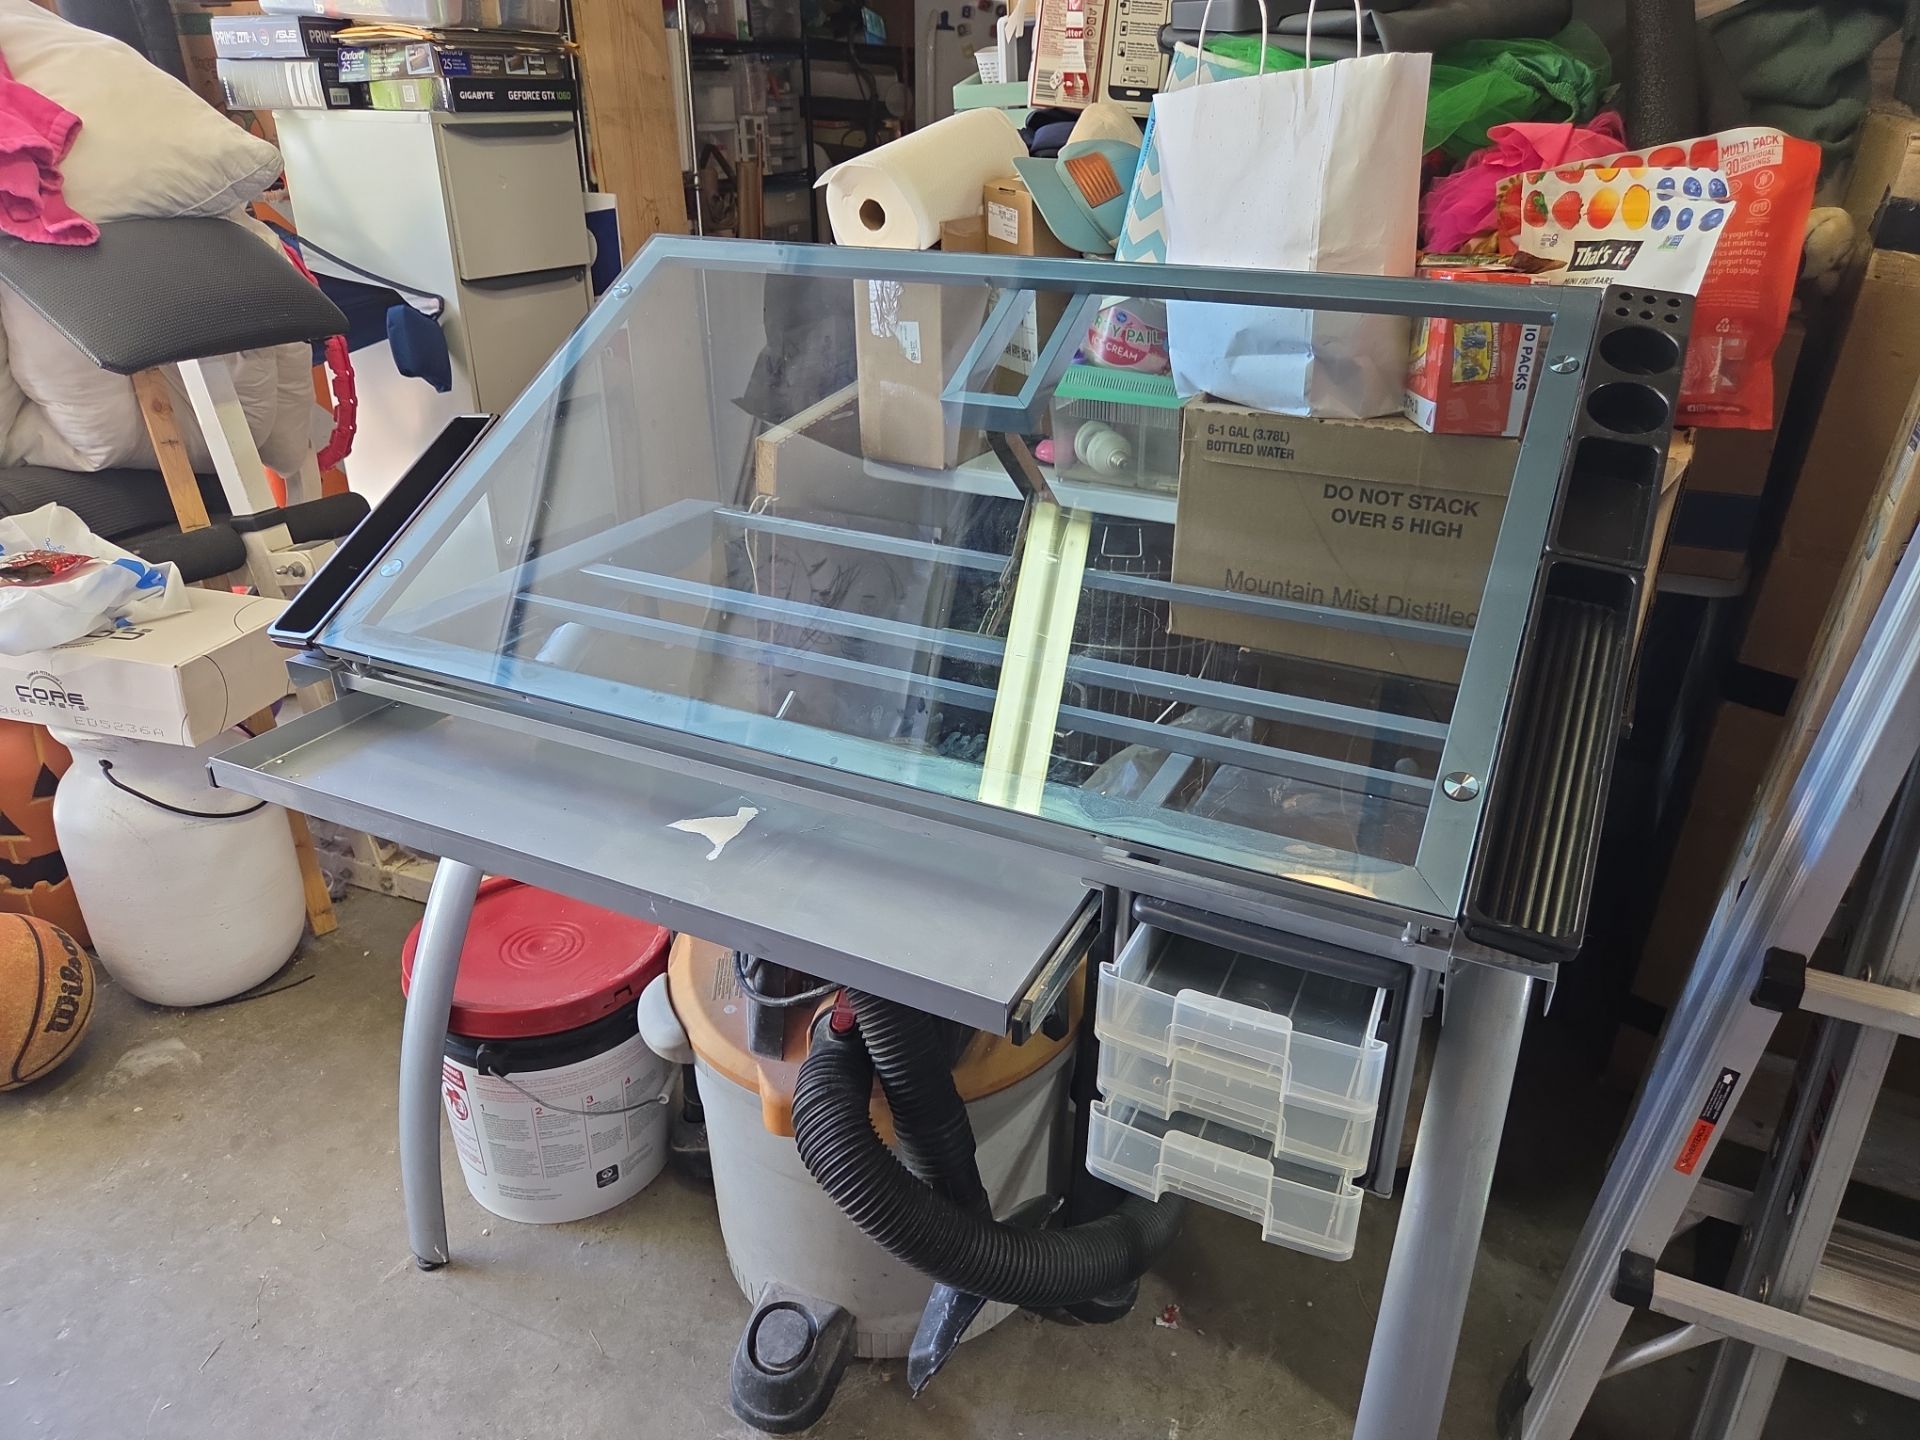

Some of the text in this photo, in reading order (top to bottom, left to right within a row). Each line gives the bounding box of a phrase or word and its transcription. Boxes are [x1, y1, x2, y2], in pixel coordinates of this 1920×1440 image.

[275, 30, 297, 39] ASUS
[340, 50, 364, 61] Oxford
[342, 61, 351, 72] 25
[442, 58, 453, 70] 25
[459, 91, 494, 100] GIGABYTE
[507, 90, 540, 100] GEFORCE
[541, 91, 555, 100] GTX
[1721, 135, 1780, 159] MULTI PACK
[1740, 149, 1776, 163] INDIVIDUAL
[1740, 157, 1772, 171] SERVINGS
[1726, 158, 1740, 176] 30
[1574, 244, 1632, 267] That's it
[1743, 248, 1767, 258] dietary
[1564, 277, 1614, 285] MINI FRUIT BARS
[1126, 328, 1161, 345] PAIL
[1105, 342, 1138, 361] CREAM
[1514, 327, 1538, 391] 10 PACKS
[1207, 424, 1291, 445] 6-1 GAL (3.78L)
[1206, 440, 1295, 460] BOTTLED WATER
[1323, 483, 1480, 517] DO NOT STACK
[1331, 508, 1463, 539] OVER 5 HIGH
[1225, 568, 1325, 605] Mountain
[1332, 586, 1379, 614] Mist
[15, 685, 85, 706] CORE
[18, 696, 88, 712] SECRETS
[586, 1095, 594, 1104] 3
[535, 1106, 544, 1115] 2
